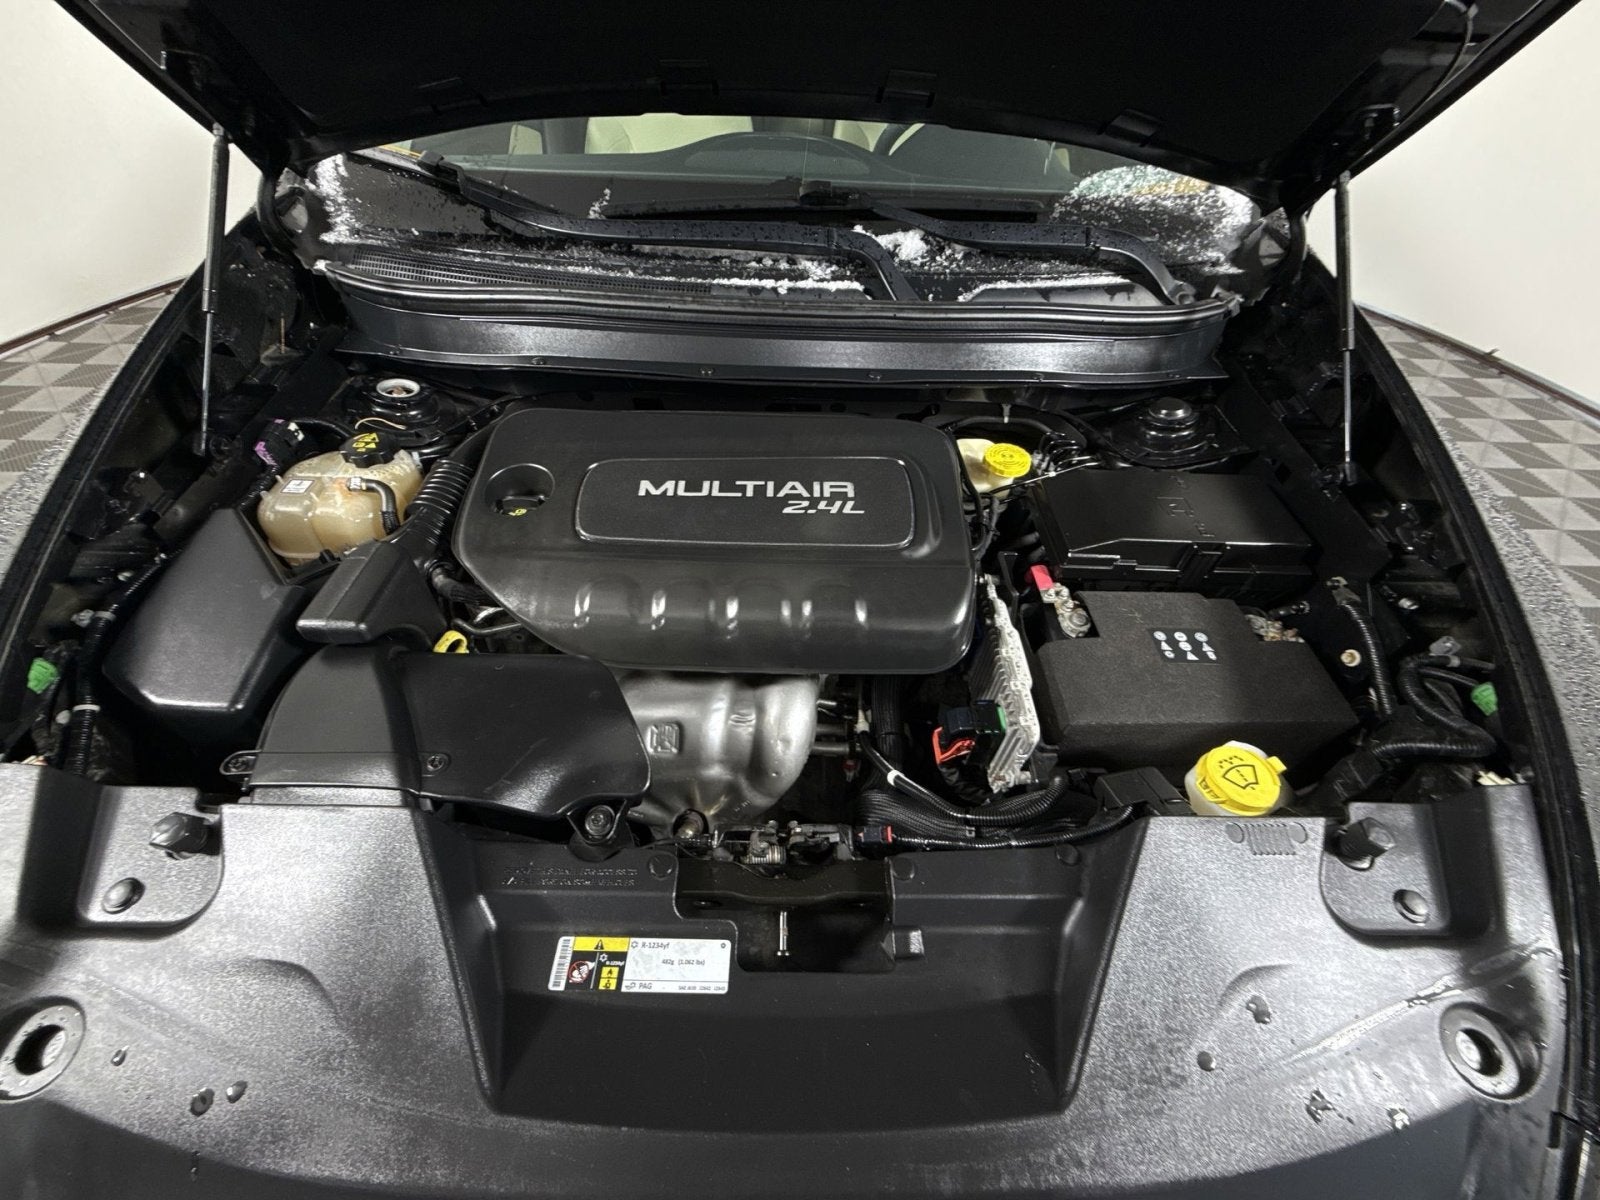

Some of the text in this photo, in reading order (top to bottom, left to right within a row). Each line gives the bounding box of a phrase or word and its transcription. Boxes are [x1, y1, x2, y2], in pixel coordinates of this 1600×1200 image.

[637, 480, 855, 497] MULTIAIR
[781, 500, 865, 514] 2.4L
[641, 942, 670, 950] R-1234yf
[638, 982, 653, 990] PAG
